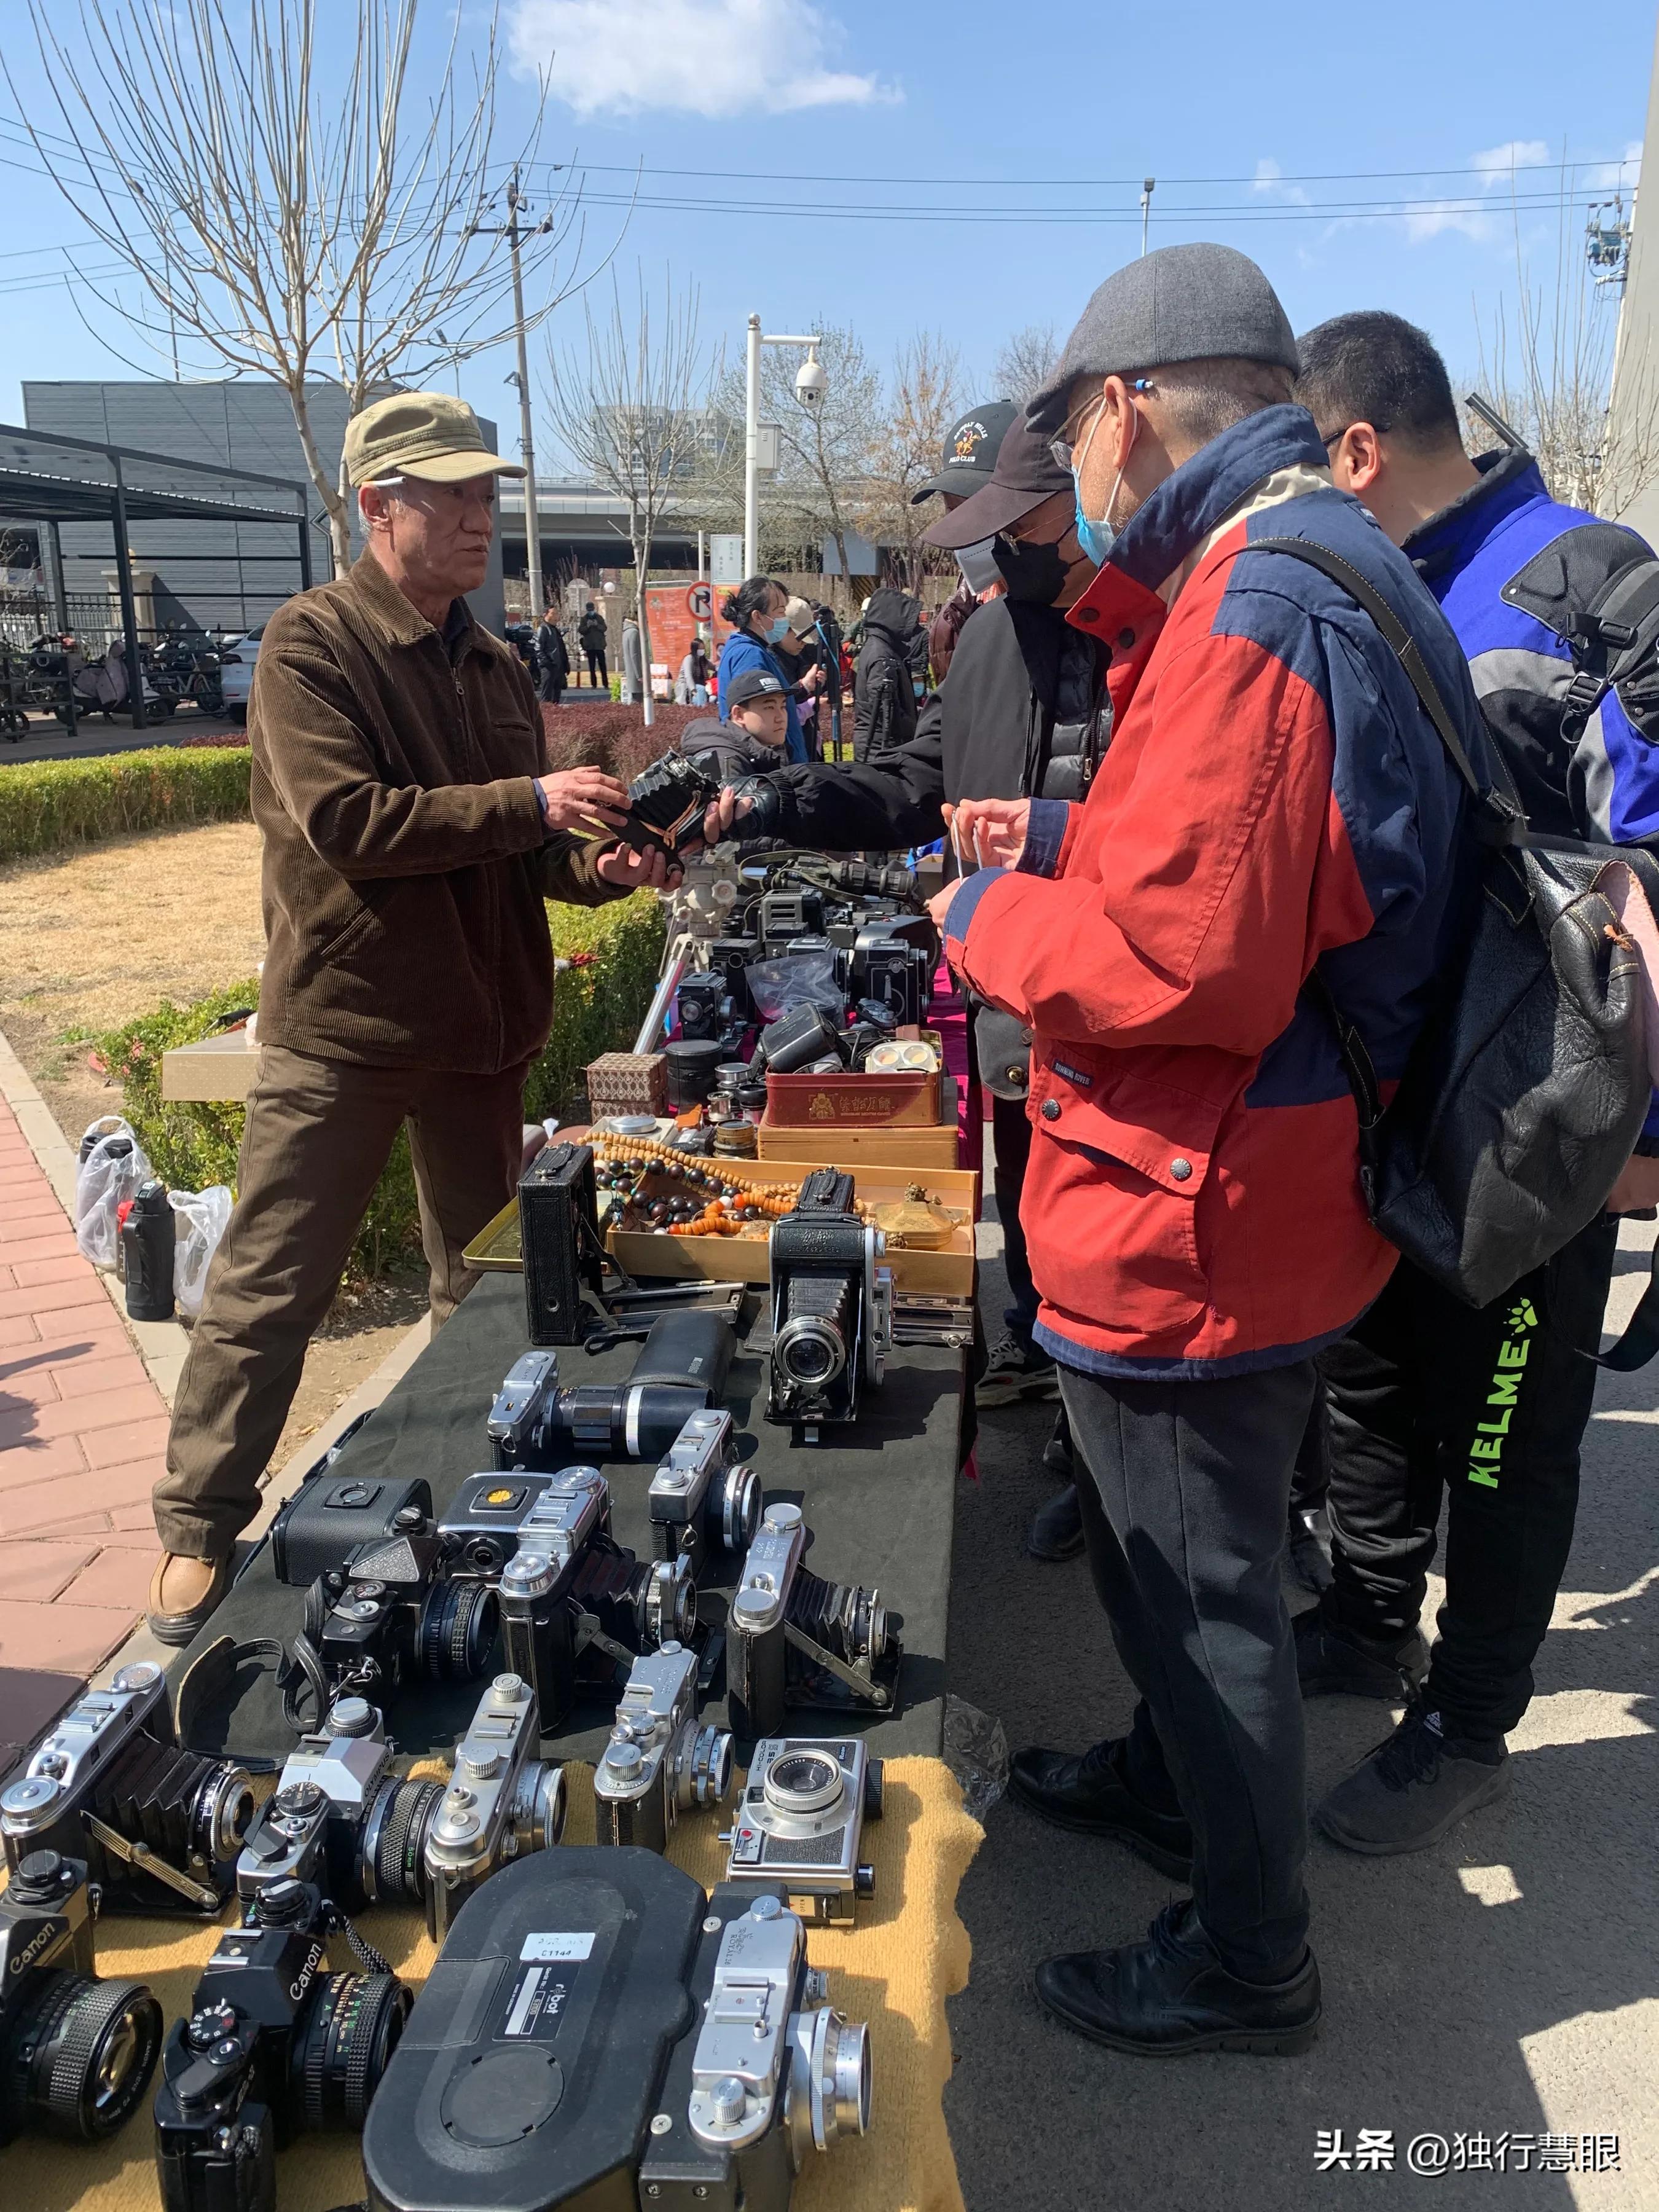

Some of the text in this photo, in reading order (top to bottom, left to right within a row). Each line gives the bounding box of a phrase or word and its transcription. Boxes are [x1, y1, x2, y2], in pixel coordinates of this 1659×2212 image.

[974, 422, 988, 439] HILLS
[1055, 1062, 1091, 1085] RUNNING RIVER
[1468, 1339, 1531, 1488] KELME
[756, 1740, 767, 1771] HI-COLOR
[364, 1752, 390, 1797] OLYMPUS
[10, 1922, 55, 1975] Canon
[726, 1934, 738, 1958] ROYAL
[289, 1943, 323, 2001] Canon
[546, 1983, 566, 2014] robot
